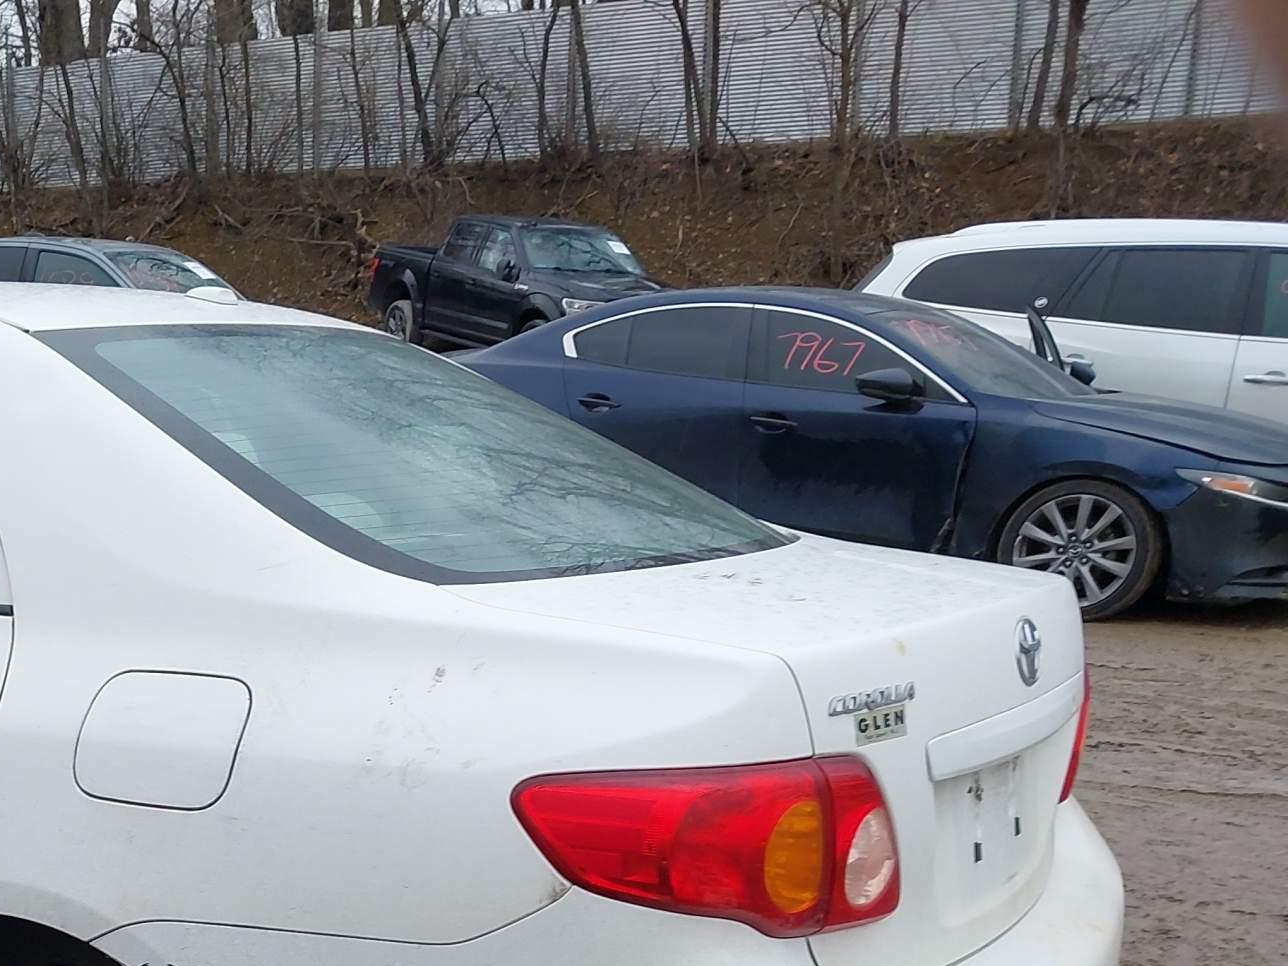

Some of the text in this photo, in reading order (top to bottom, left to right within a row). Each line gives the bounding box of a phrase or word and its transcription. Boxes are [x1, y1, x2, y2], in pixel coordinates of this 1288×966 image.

[778, 331, 866, 377] 7967
[828, 681, 915, 717] COROLLA
[858, 709, 905, 734] GLEN
